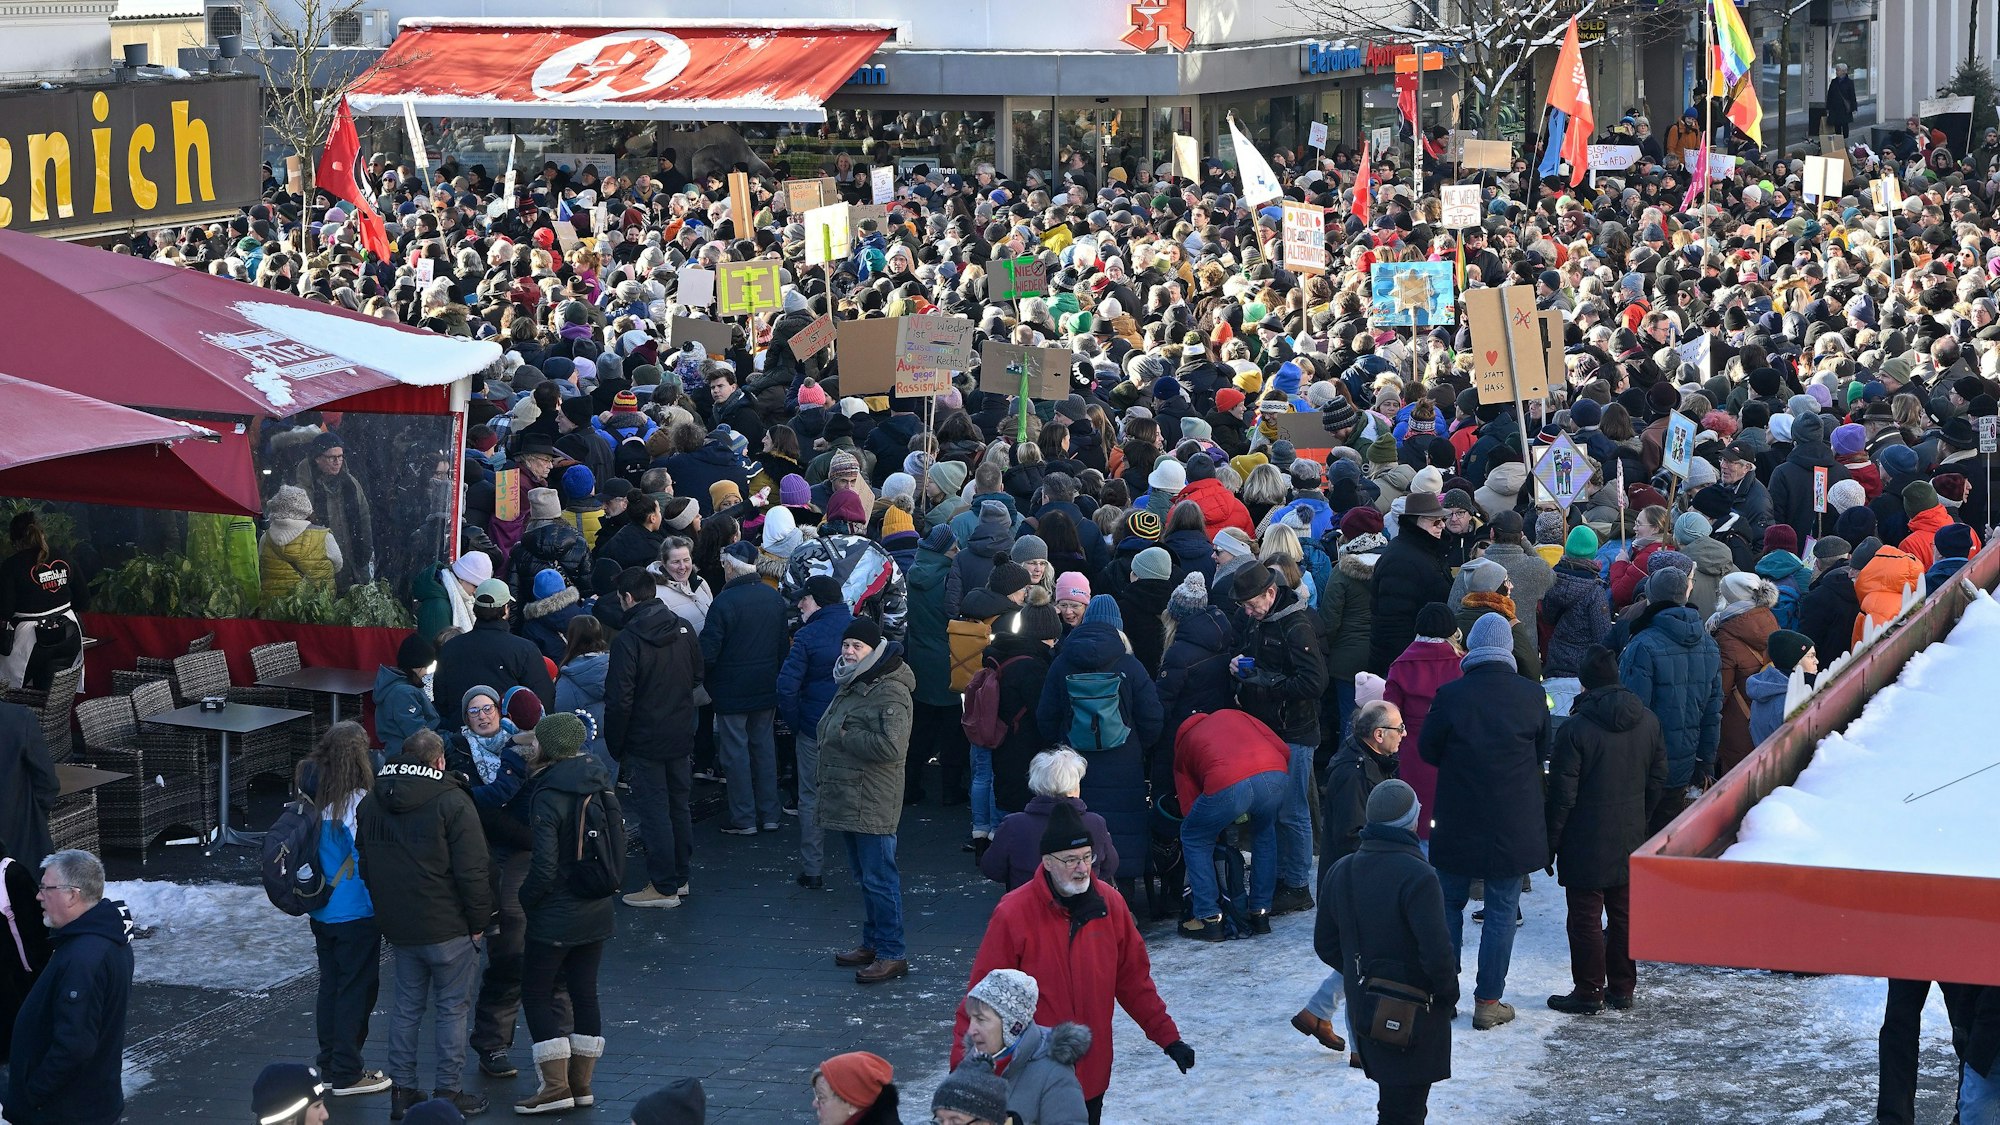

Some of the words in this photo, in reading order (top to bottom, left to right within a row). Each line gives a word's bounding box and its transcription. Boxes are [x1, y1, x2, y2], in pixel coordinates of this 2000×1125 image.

[1577, 20, 1605, 30] OLD
[1014, 265, 1031, 277] NIE
[911, 316, 932, 330] Nie
[914, 330, 926, 339] ist
[907, 341, 960, 356] Zusammen
[1484, 370, 1505, 379] STATT
[1484, 382, 1505, 393] HASS
[399, 764, 443, 781] SQUAD
